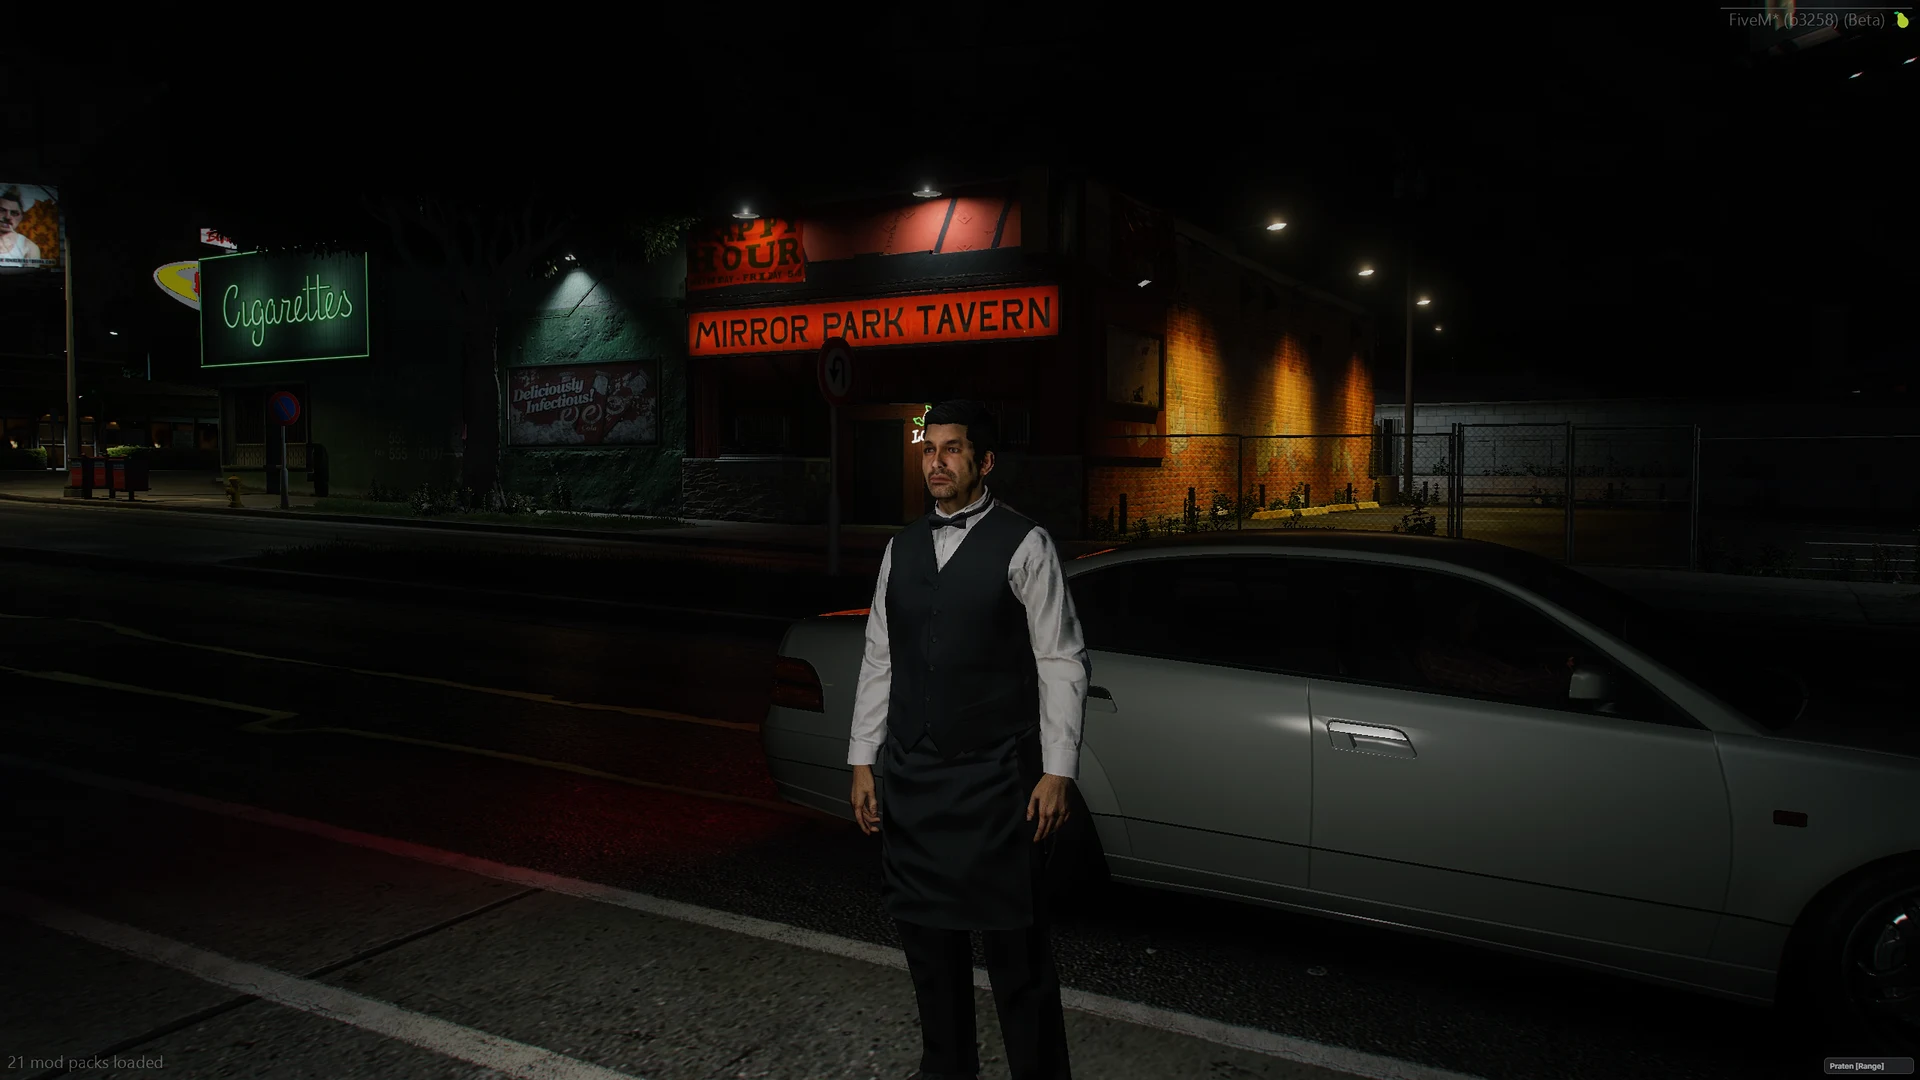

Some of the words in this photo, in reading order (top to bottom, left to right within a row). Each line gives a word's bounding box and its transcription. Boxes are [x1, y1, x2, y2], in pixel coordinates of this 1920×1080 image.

[690, 238, 802, 272] HOUR
[223, 274, 354, 347] Cigarettes
[694, 313, 809, 350] MIRROR
[822, 307, 905, 343] PARK
[916, 297, 1051, 335] TAVERN
[513, 376, 585, 403] Deliciously
[525, 387, 595, 415] Infectious!
